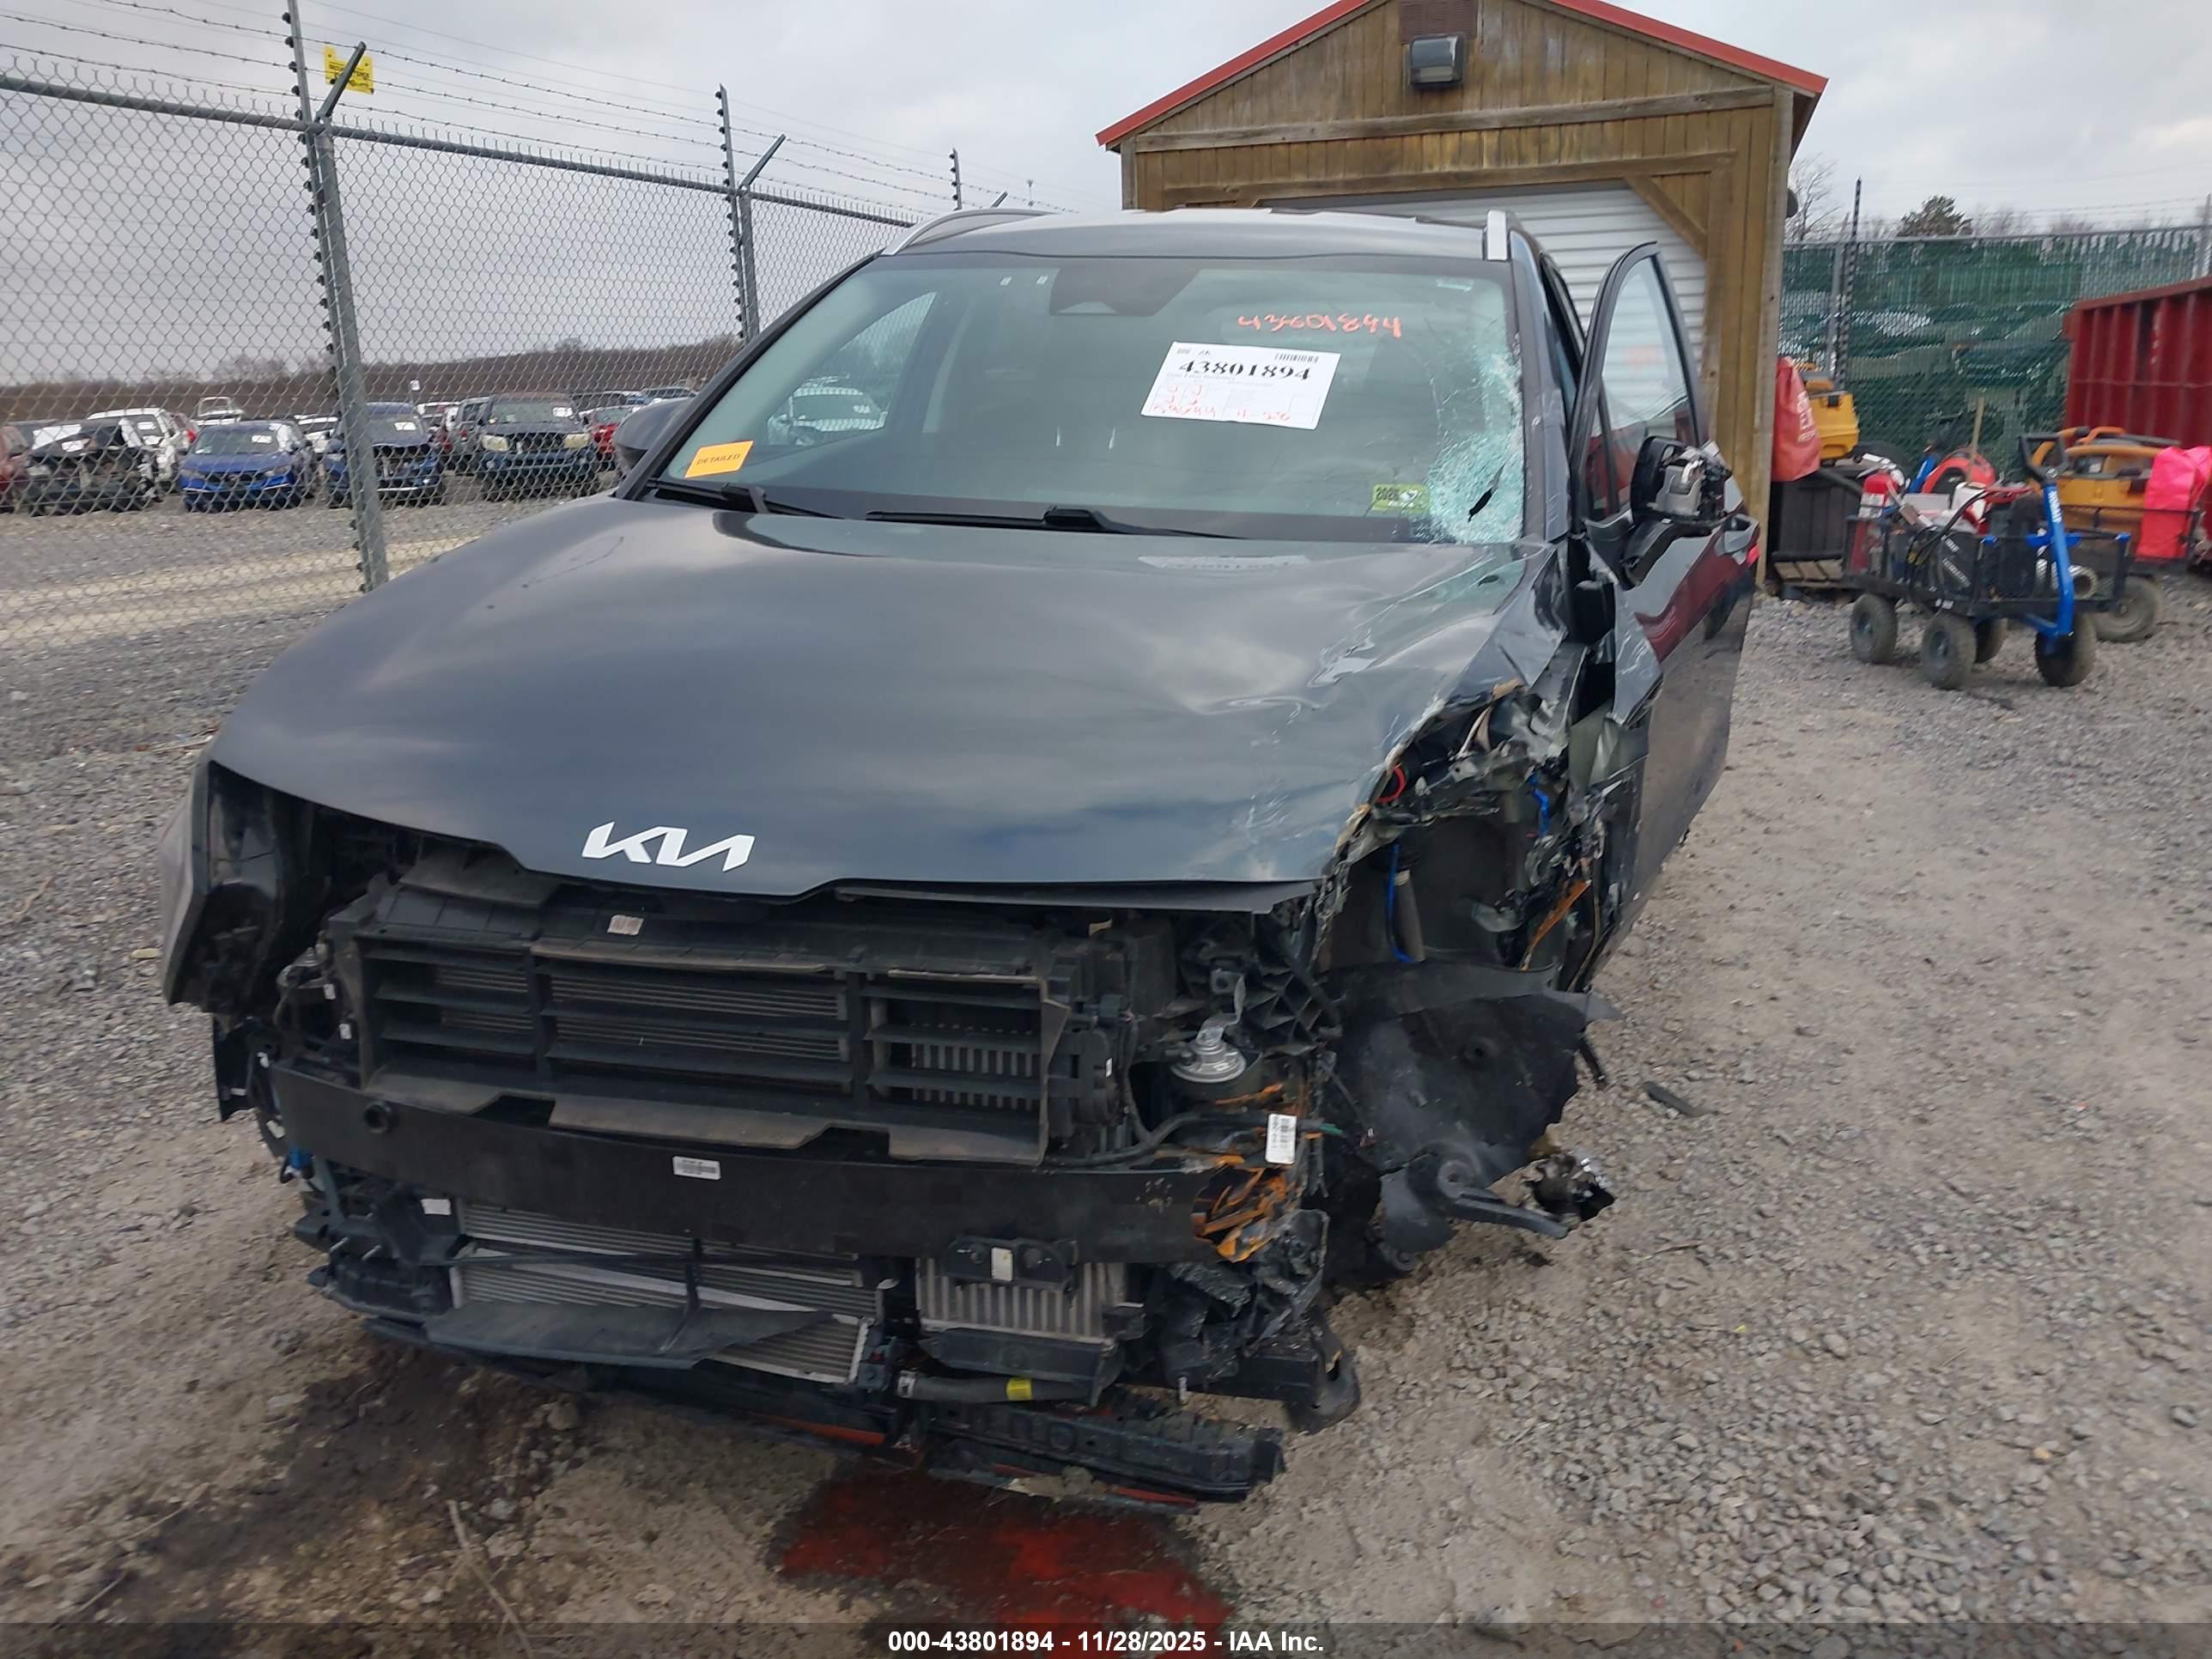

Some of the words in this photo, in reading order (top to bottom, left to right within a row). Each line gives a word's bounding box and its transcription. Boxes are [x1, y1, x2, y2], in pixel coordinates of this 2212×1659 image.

[1179, 359, 1311, 381] 43801894
[696, 454, 741, 465] DETAILED
[581, 821, 756, 872] KIA
